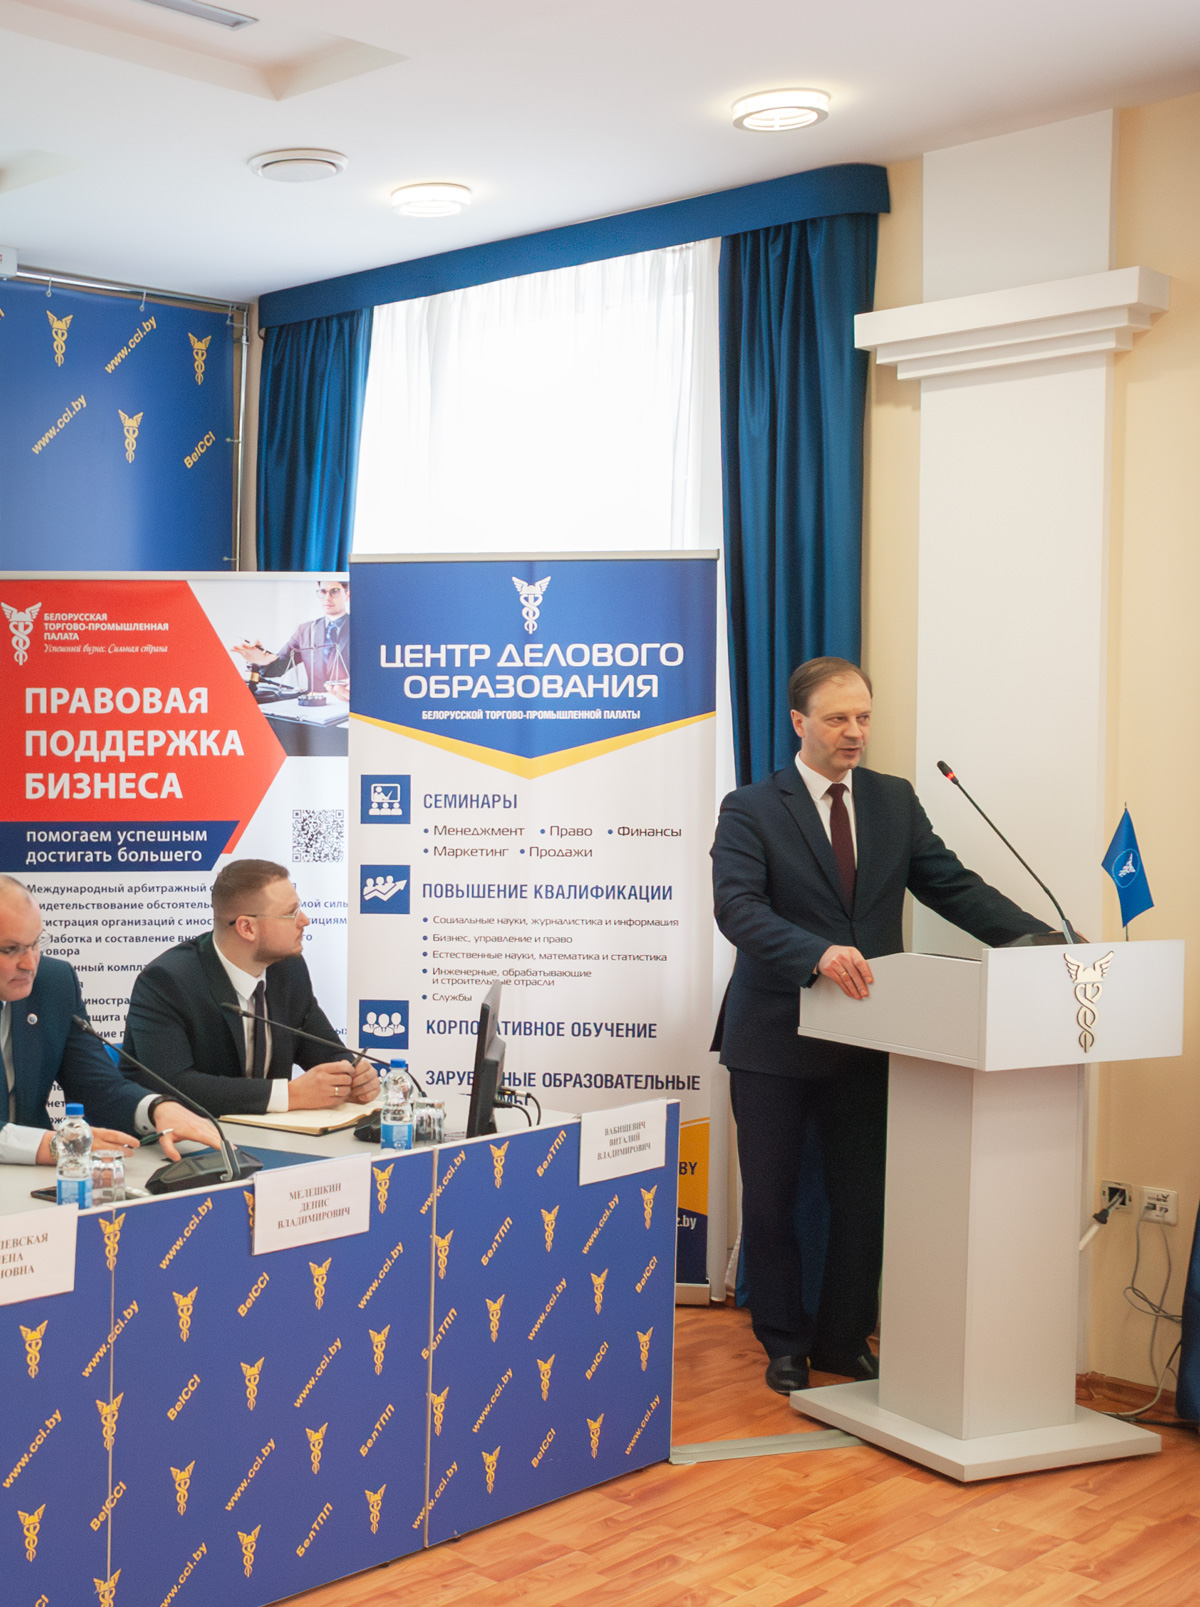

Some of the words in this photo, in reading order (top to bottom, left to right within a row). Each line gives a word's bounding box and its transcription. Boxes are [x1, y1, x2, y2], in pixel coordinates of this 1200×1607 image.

[105, 316, 157, 374] www.cci.by
[32, 395, 87, 454] www.cci.by
[183, 431, 216, 469] BelCCI
[43, 612, 108, 621] БЕЛОРУССКАЯ
[43, 622, 169, 631] ТОРГОВО-ПРОМЫШЛЕННАЯ
[43, 632, 80, 641] ПАЛАТА
[43, 643, 81, 653] Успешный
[108, 643, 139, 654] Сильная
[140, 643, 168, 654] страна
[380, 644, 491, 669] ЦЕНТР
[497, 642, 684, 668] ДЕЛОВОГО
[403, 674, 659, 699] ОБРАЗОВАНИЯ
[25, 686, 209, 714] ПРАВОВАЯ
[422, 708, 483, 720] БЕЛОРУССКОЙ
[485, 708, 602, 720] ТОРГОВО-ПРОМЫШЛЕННОЙ
[603, 709, 641, 720] ПАЛАТЫ
[25, 729, 245, 763] ПОДДЕРЖКА
[25, 772, 184, 800] БИЗНЕСА
[423, 793, 518, 809] СЕМИНАРЫ
[26, 829, 111, 842] помогаем
[117, 828, 208, 845] успешным
[433, 825, 525, 838] Менеджмент
[549, 825, 593, 838] Право
[617, 825, 682, 838] Финансы
[26, 848, 112, 865] достигать
[117, 845, 203, 863] большего
[433, 845, 509, 859] Маркетинг
[529, 846, 593, 859] Продажи
[27, 884, 125, 895] Международный
[127, 883, 207, 893] арбитражный
[422, 882, 528, 900] ПОВЫШЕНИЕ
[533, 883, 673, 903] КВАЛИФИКАЦИИ
[101, 917, 175, 928] организаций
[177, 918, 183, 926] с
[432, 915, 495, 926] Социальные
[496, 918, 528, 927] науки,
[530, 917, 603, 928] журналистика
[613, 917, 679, 928] информация
[95, 935, 102, 943] и
[104, 935, 176, 943] составление
[432, 933, 471, 944] Бизнес,
[473, 935, 533, 945] управление
[534, 936, 542, 944] и
[543, 936, 573, 946] право
[432, 950, 503, 960] Естественные
[504, 952, 537, 961] науки,
[538, 952, 600, 961] математика
[602, 953, 609, 961] и
[610, 953, 668, 962] статистика
[432, 967, 499, 977] Инженерные,
[502, 967, 592, 978] обрабатывающие
[432, 977, 439, 985] и
[440, 977, 512, 986] строительые
[513, 978, 555, 987] отрасли
[432, 992, 473, 1003] Службы
[571, 1021, 658, 1039] ОБУЧЕНИЕ
[542, 1072, 701, 1091] ОБРАЗОВАТЕЛЬНЫЕ
[537, 1130, 568, 1177] БелТПП
[289, 1182, 341, 1200] МЕЛЕШКИН
[277, 1206, 350, 1229] ВЛАДИМИРОВИЧ
[299, 1198, 330, 1213] ДЕНИС
[159, 1197, 213, 1270] www.cci.by
[582, 1194, 619, 1255] www.cci.by
[480, 1216, 513, 1266] БелТПП
[357, 1241, 404, 1309] www.cci.by
[635, 1255, 658, 1294] BelCCI
[237, 1271, 270, 1317] BelCCI
[527, 1278, 567, 1341] www.cci.by
[293, 1337, 342, 1408] www.cci.by
[585, 1341, 609, 1381] BelCCI
[166, 1373, 201, 1421] BelCCI
[472, 1367, 513, 1433] www.cci.by
[359, 1403, 395, 1457] БелТПП
[624, 1394, 661, 1456] www.cci.by
[2, 1408, 62, 1489] www.cci.by
[531, 1427, 556, 1468] BelCCI
[224, 1438, 276, 1511] www.cci.by
[89, 1480, 128, 1532] BelCCI
[295, 1502, 333, 1558] БелТПП
